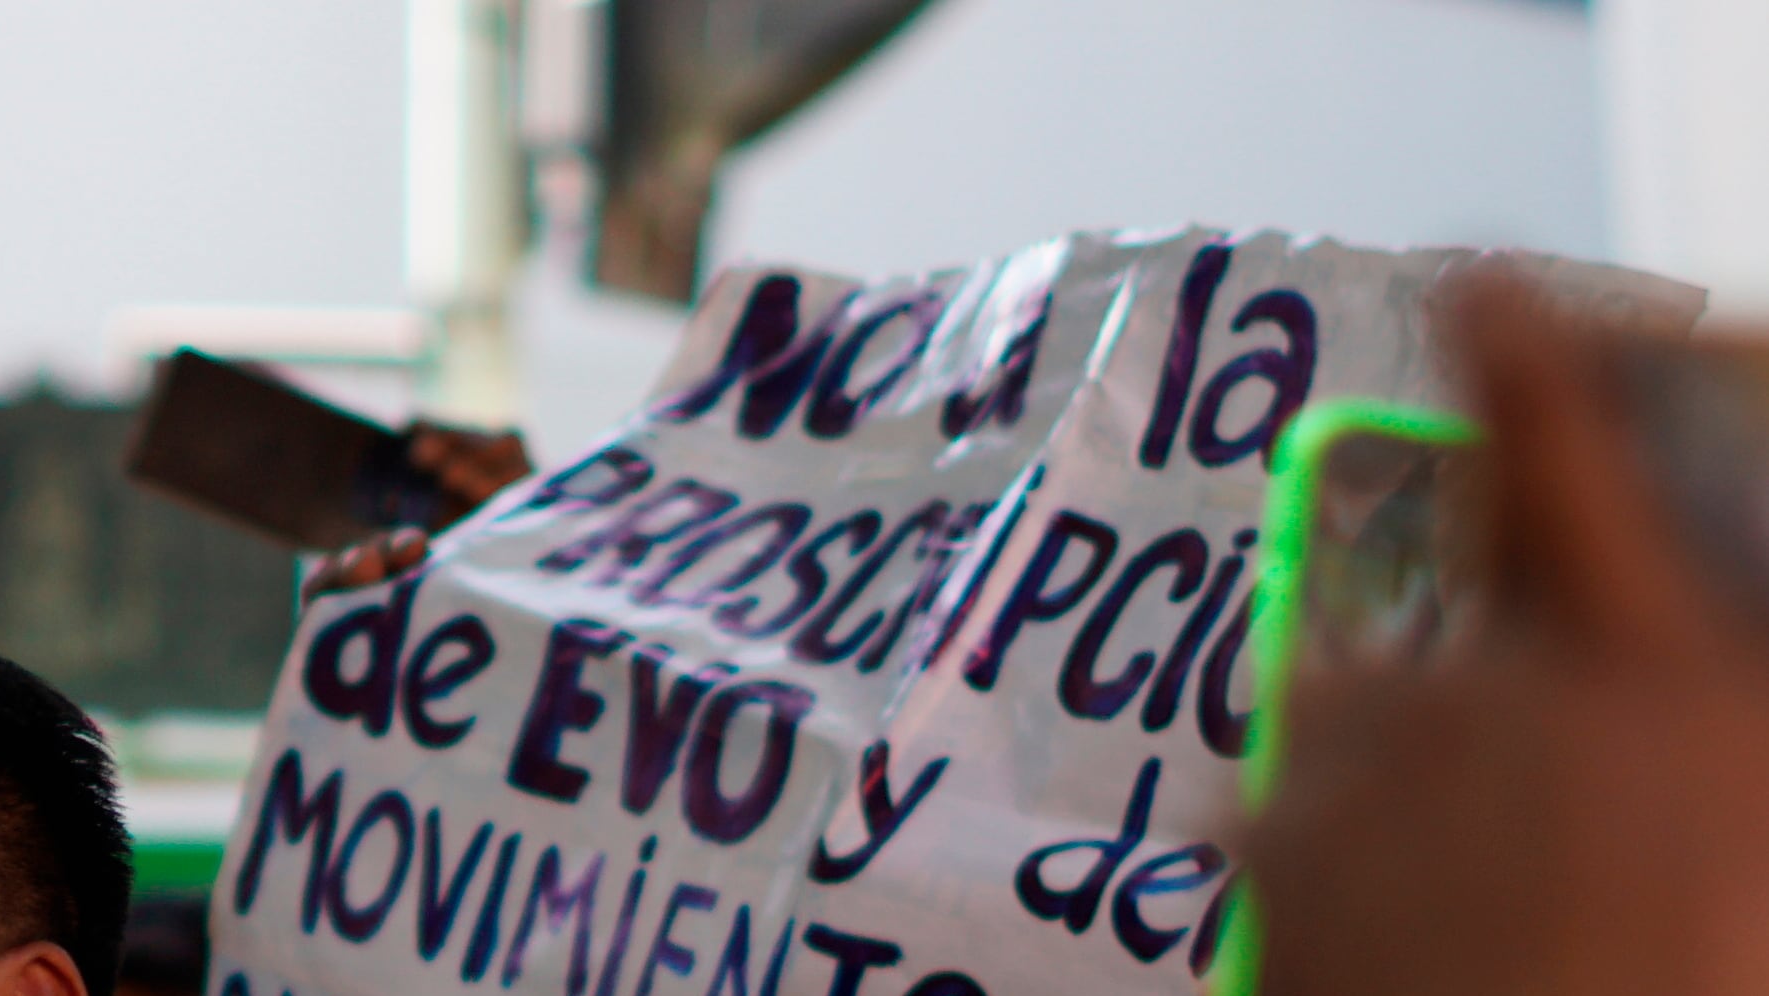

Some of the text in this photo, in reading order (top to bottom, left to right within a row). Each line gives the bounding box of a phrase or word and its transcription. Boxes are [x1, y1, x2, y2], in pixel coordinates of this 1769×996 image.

[1140, 245, 1318, 472] la
[303, 572, 495, 748] de
[507, 616, 817, 844] EVO
[807, 738, 951, 885] y
